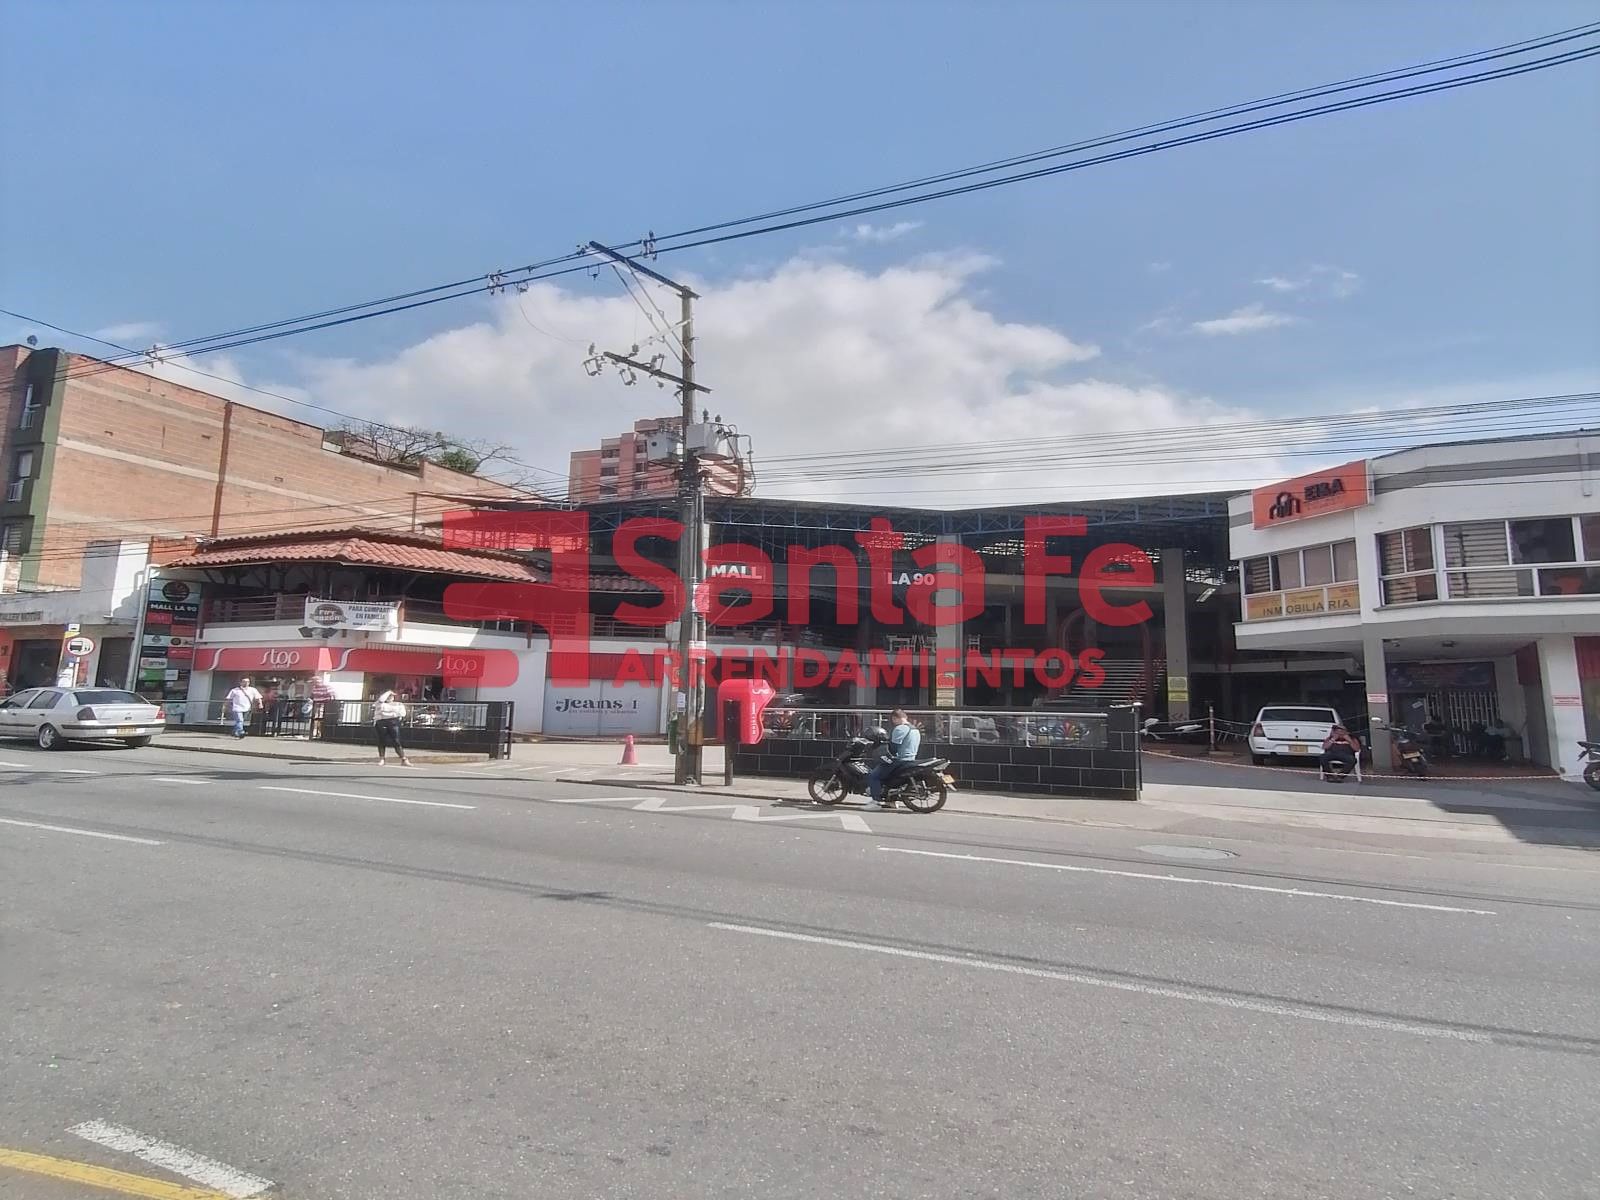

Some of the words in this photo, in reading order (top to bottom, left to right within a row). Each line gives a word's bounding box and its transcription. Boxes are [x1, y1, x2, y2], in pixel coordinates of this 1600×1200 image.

[711, 564, 763, 580] MALL
[887, 572, 911, 585] LA
[913, 573, 935, 586] 90
[150, 603, 172, 611] MALL
[1263, 599, 1351, 616] INMOBILIARIA
[259, 648, 300, 668] stop
[436, 656, 477, 675] stop
[555, 698, 623, 712] Jeans
